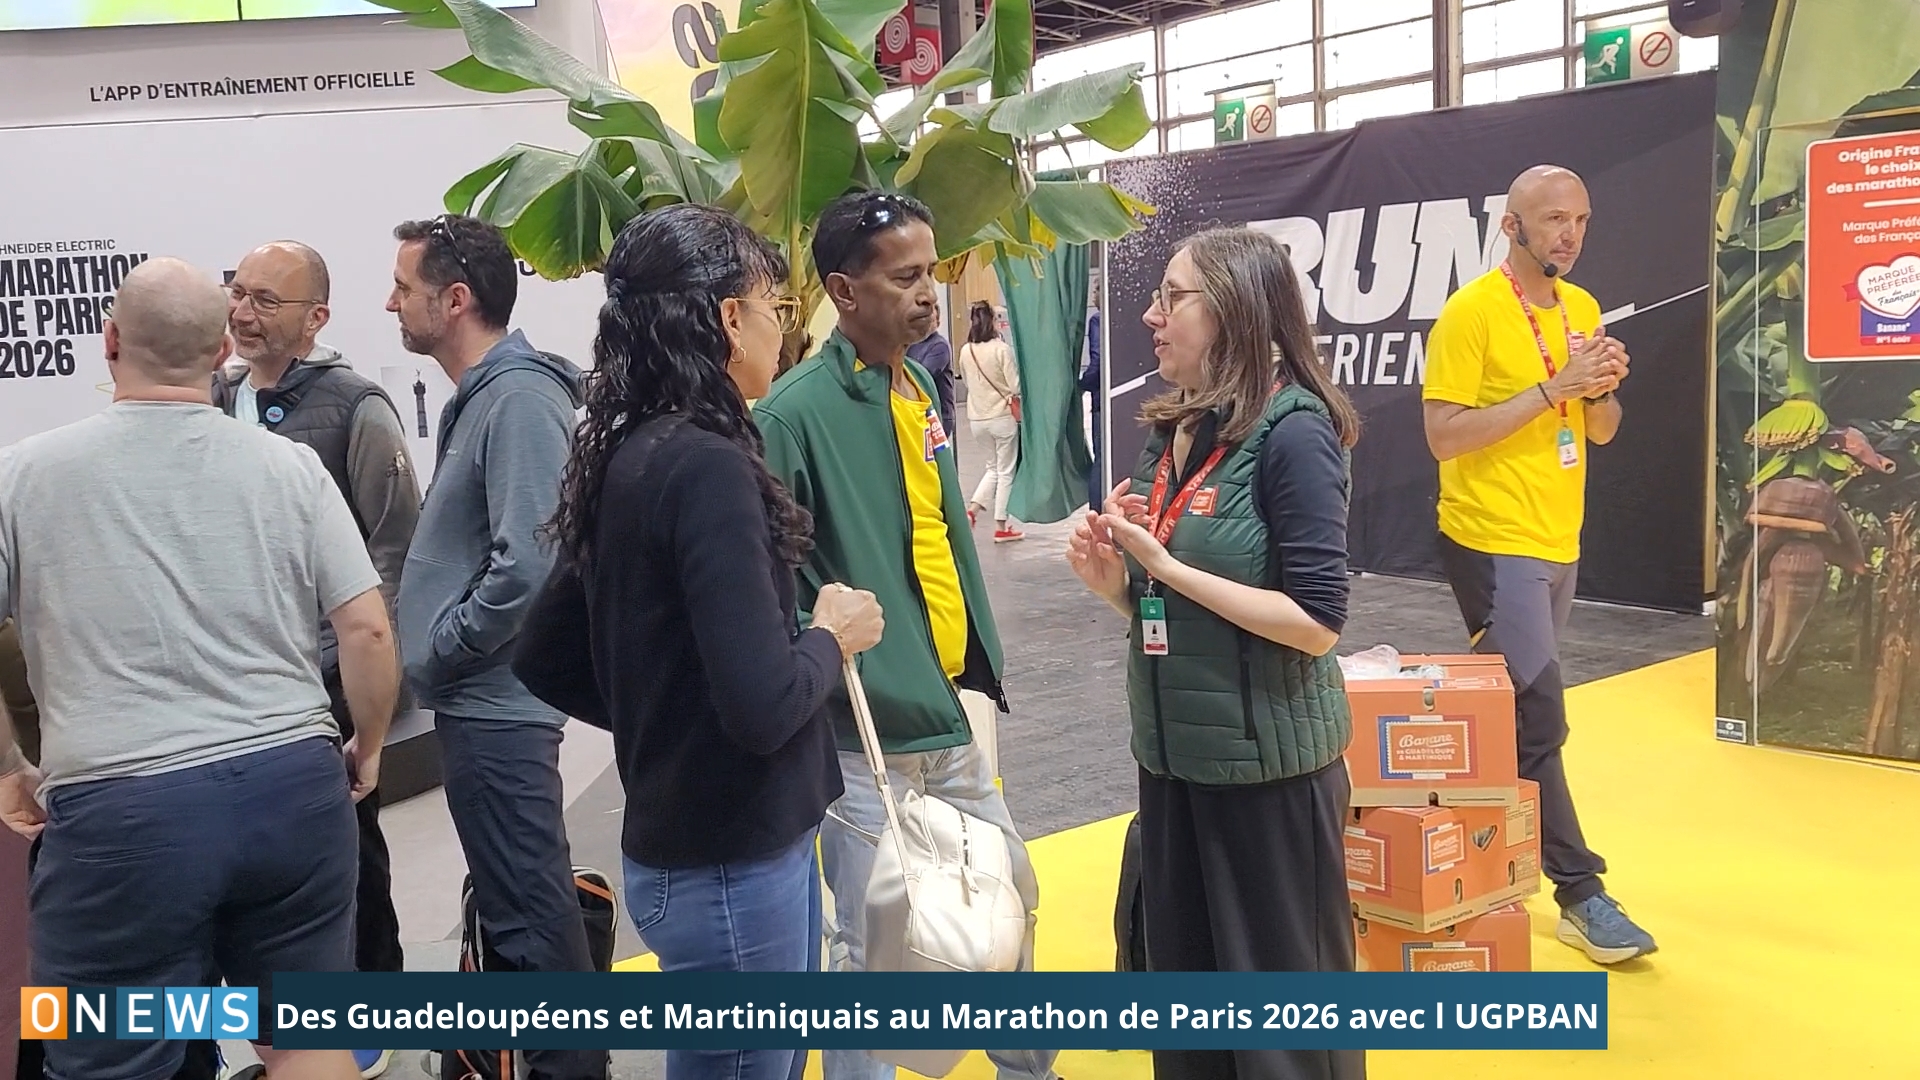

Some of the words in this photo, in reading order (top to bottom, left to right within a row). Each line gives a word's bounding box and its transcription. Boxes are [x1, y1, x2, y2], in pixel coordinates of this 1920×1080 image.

[90, 85, 141, 102] L'APP
[147, 76, 308, 100] D'ENTRAÎNEMENT
[314, 70, 415, 91] OFFICIELLE
[1838, 147, 1893, 164] Origine
[1865, 163, 1879, 175] le
[1880, 159, 1920, 174] choix
[1826, 182, 1854, 195] des
[1842, 219, 1890, 233] Marque
[56, 239, 116, 252] ELECTRIC
[1854, 233, 1878, 245] des
[1867, 264, 1915, 286] MARQUE
[0, 338, 76, 379] 2026
[1398, 733, 1460, 749] Banane
